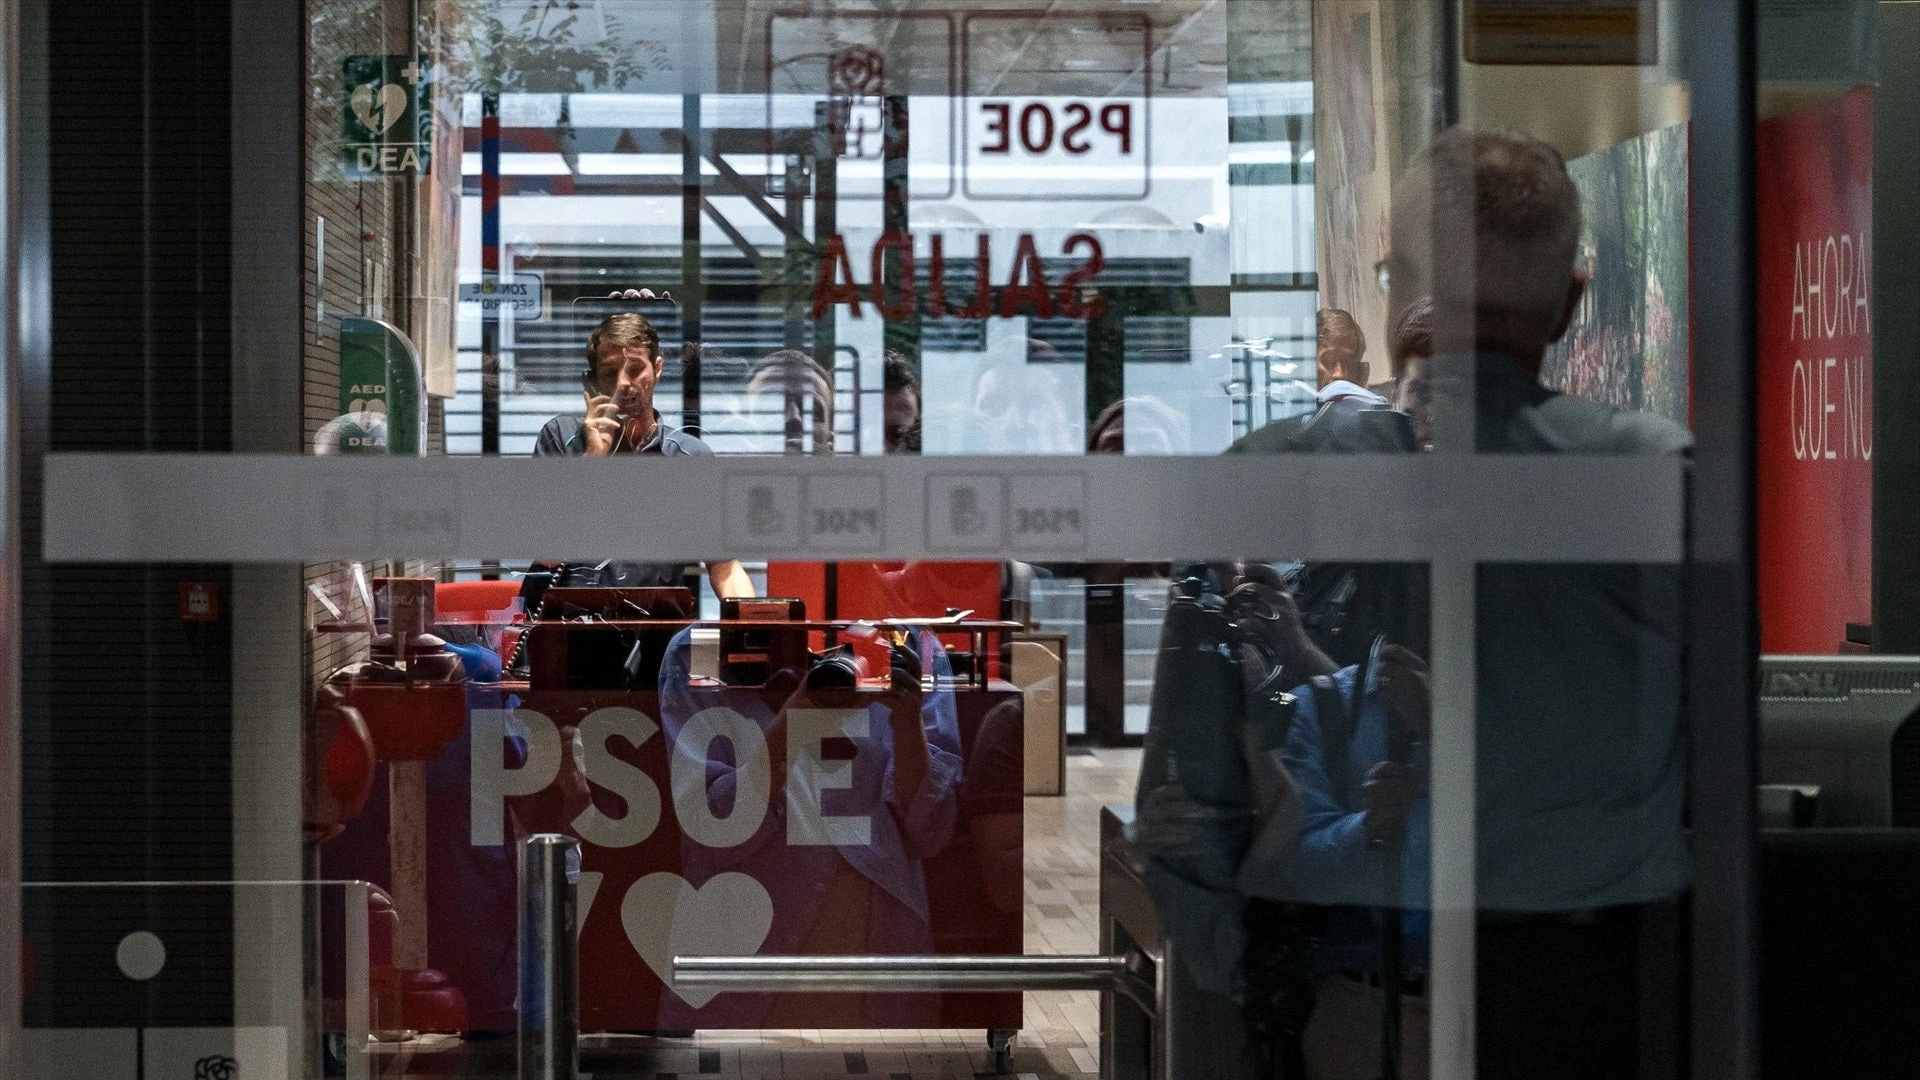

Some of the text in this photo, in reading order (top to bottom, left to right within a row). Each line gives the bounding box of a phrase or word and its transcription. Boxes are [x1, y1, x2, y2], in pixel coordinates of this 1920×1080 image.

[357, 147, 422, 172] DEA
[1791, 233, 1870, 340] AHORA
[349, 384, 386, 394] AED
[1791, 359, 1836, 460] QUE
[348, 437, 387, 447] DEA
[471, 706, 871, 848] PSOE
